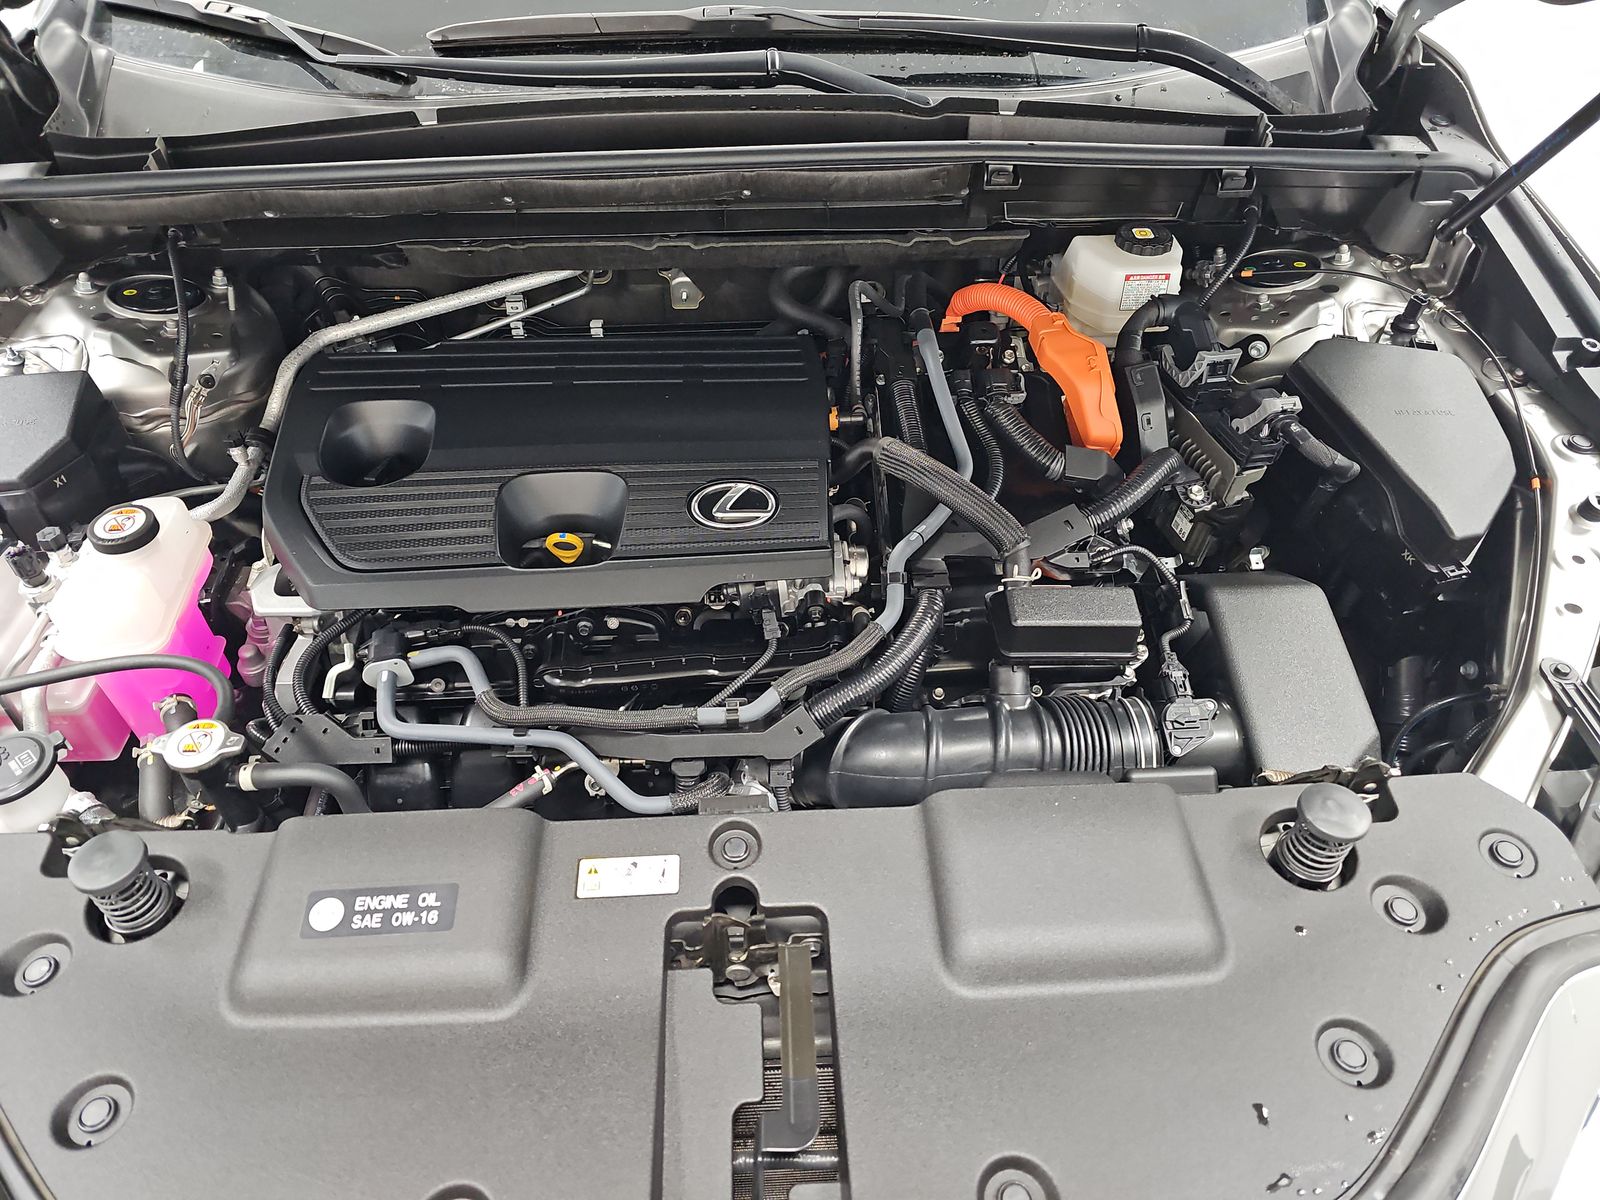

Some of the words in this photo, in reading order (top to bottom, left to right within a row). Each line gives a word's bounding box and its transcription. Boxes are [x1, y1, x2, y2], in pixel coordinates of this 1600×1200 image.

[53, 474, 67, 488] X1
[354, 893, 410, 911] ENGINE
[417, 892, 441, 908] OIL
[350, 912, 384, 930] SAE
[391, 909, 439, 928] 0W-16
